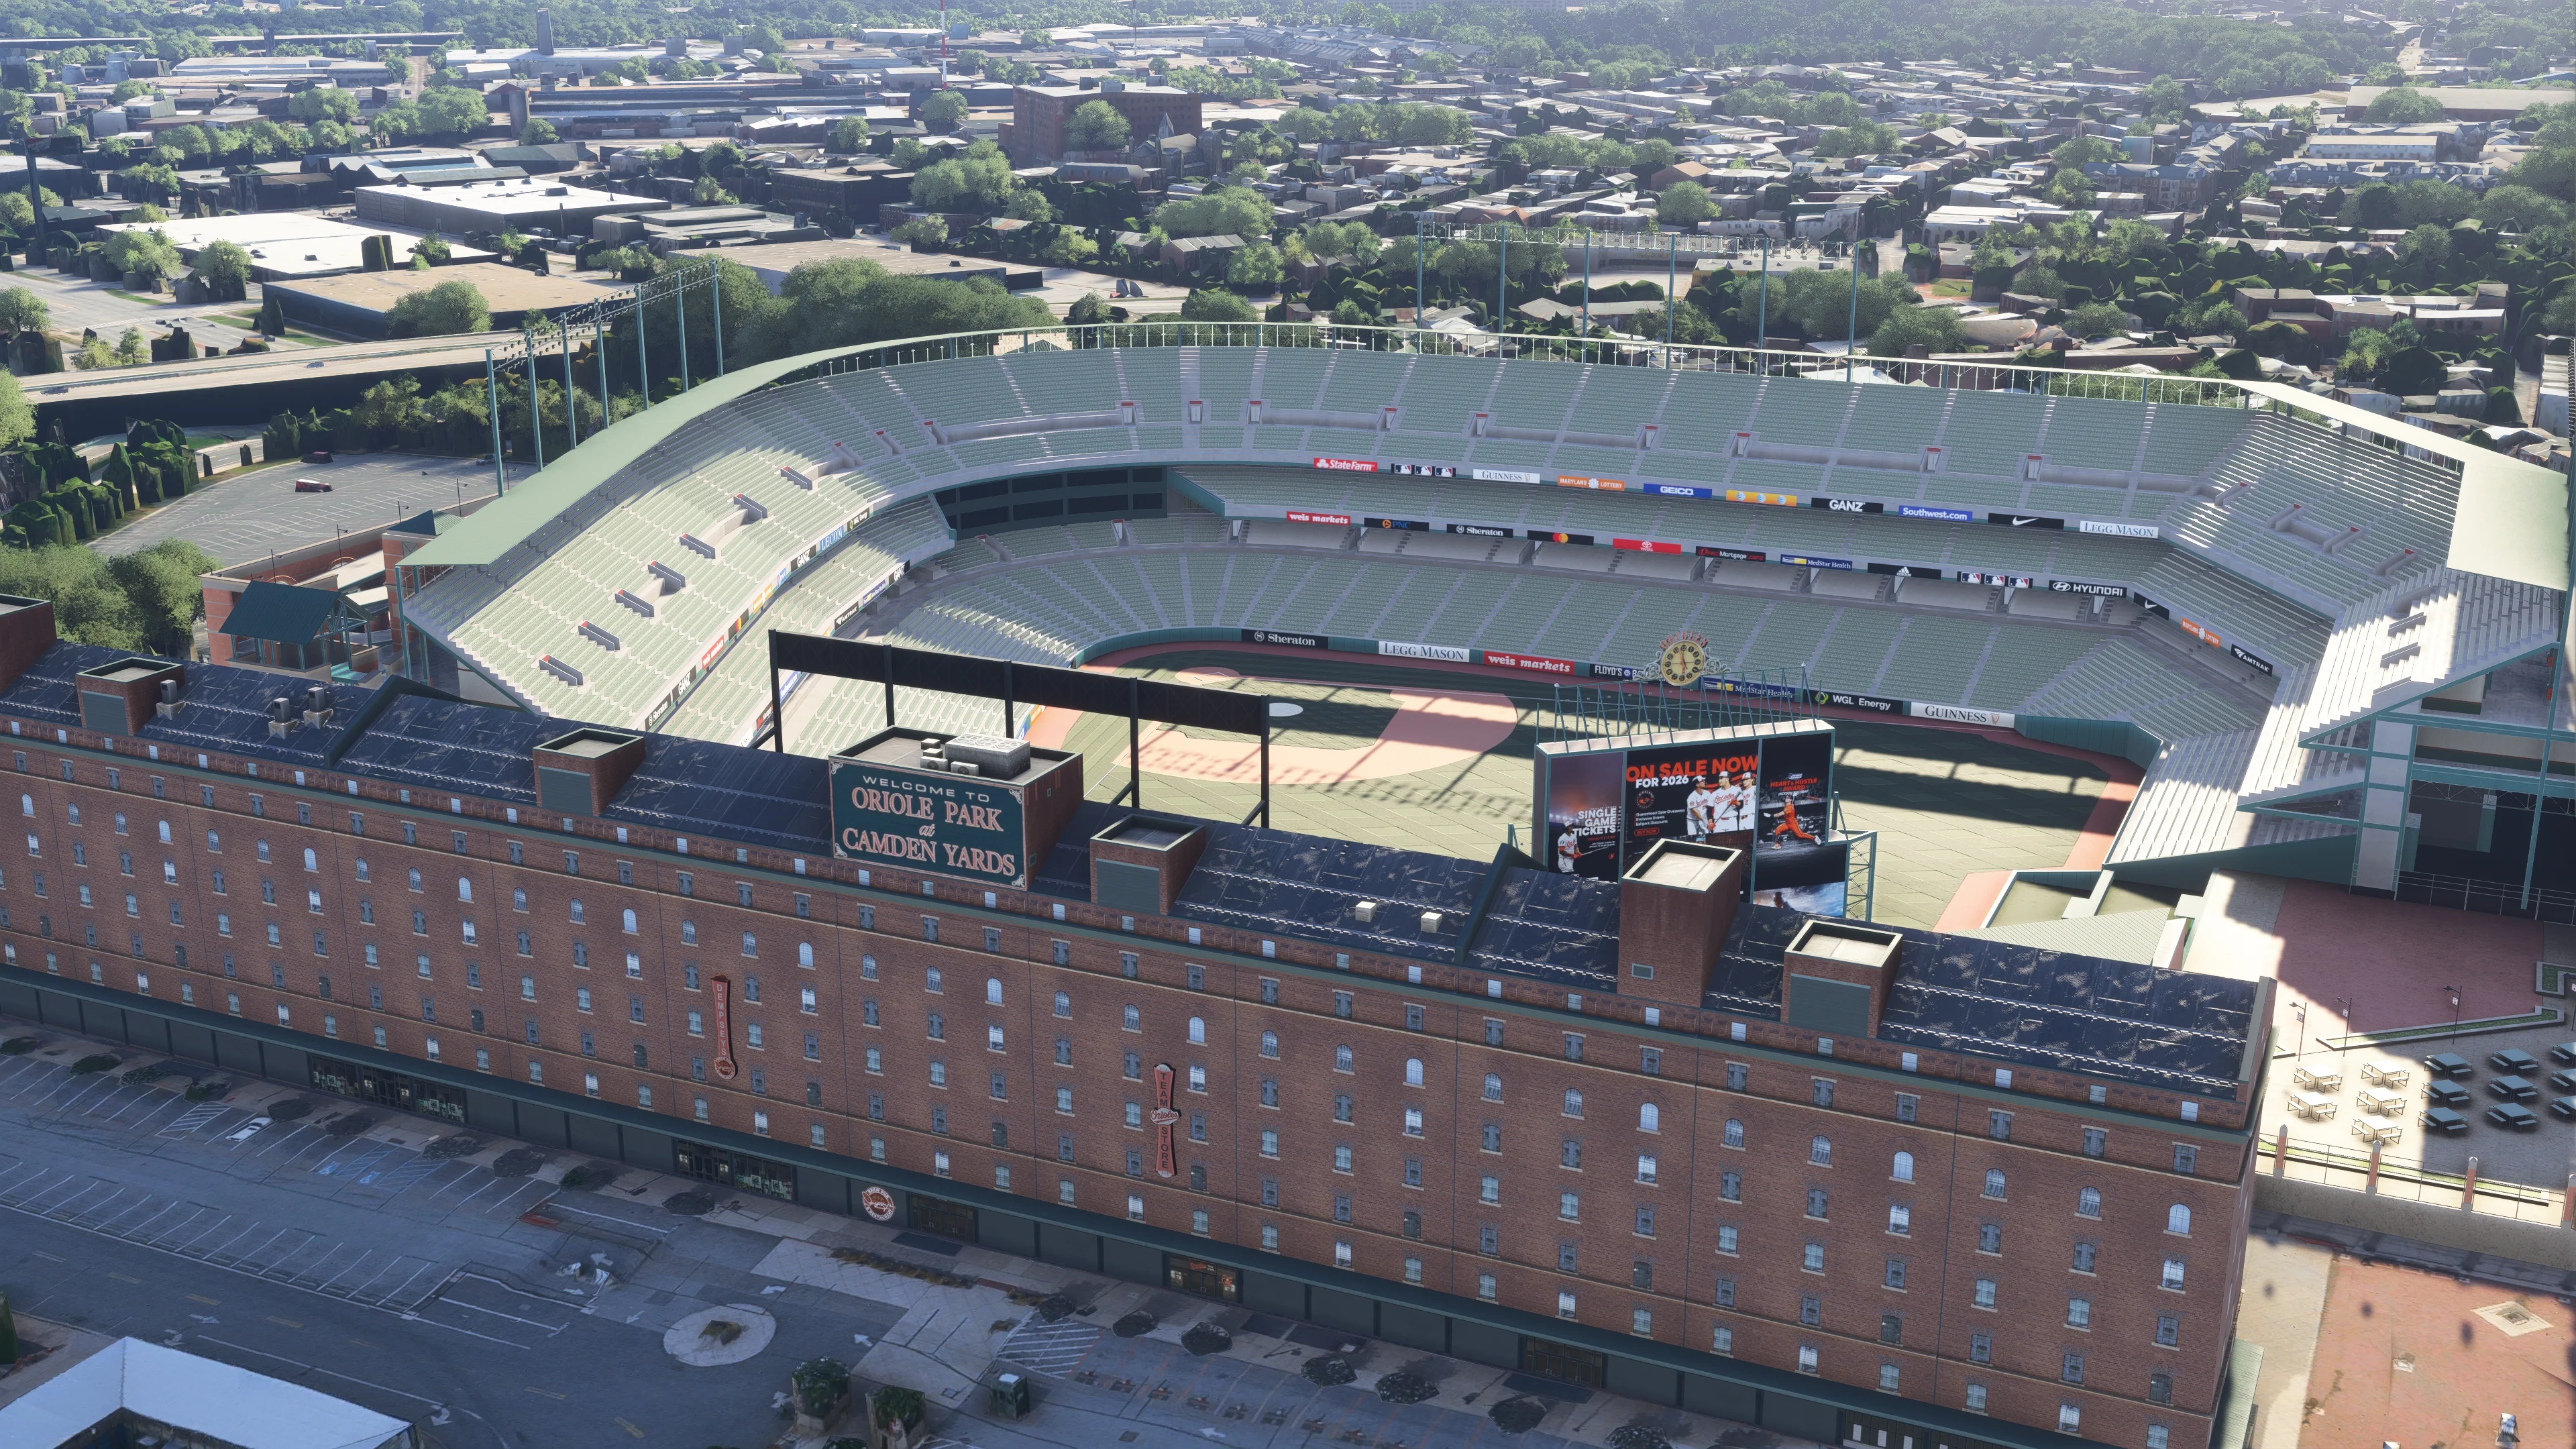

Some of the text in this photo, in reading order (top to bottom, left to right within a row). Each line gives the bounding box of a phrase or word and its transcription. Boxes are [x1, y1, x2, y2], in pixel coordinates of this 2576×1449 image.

[1482, 470, 1522, 481] GUINNESS
[1560, 478, 1587, 486] MARYLAND
[1660, 486, 1694, 496] GEICO
[1829, 499, 1864, 512] GANZ
[1289, 513, 1348, 524] weis markets
[1902, 507, 1968, 521] Southwest.com
[1393, 521, 1411, 529] PNC
[1466, 526, 1503, 536] Sheraton
[2084, 522, 2154, 537] LEGG MASON
[821, 527, 843, 551] LECOM
[796, 549, 810, 568] GANZ
[1808, 559, 1831, 568] MedStar
[2073, 584, 2123, 596] HYUNDAI
[841, 606, 857, 622] AMTRAK
[1268, 633, 1316, 646] Sheraton
[2182, 621, 2219, 645] MARYLAND LOTTERY
[1384, 643, 1464, 660] LEGG MASON
[1488, 656, 1570, 672] weis markets
[1595, 665, 1622, 676] FLOYD'S
[2243, 655, 2269, 672] AMTRAK
[1735, 685, 1792, 698] MedStar Health
[1832, 695, 1891, 710] WGL Energy
[1925, 705, 1986, 722] GUINNESS
[1626, 754, 1758, 782] ON SALE NOW
[862, 775, 989, 803] WELCOME TO
[1635, 775, 1689, 789] FOR 2026
[851, 787, 1004, 832] ORIOLE PARK
[1578, 808, 1617, 819] SINGLE
[1585, 816, 1616, 827] GAME
[918, 823, 936, 837] at
[1572, 825, 1616, 837] TICKETS
[843, 828, 1016, 877] CAMDEN YARDS
[716, 984, 727, 1056] DEMPSEYS
[1160, 1073, 1168, 1107] TEAM
[1150, 1110, 1178, 1120] Orioles
